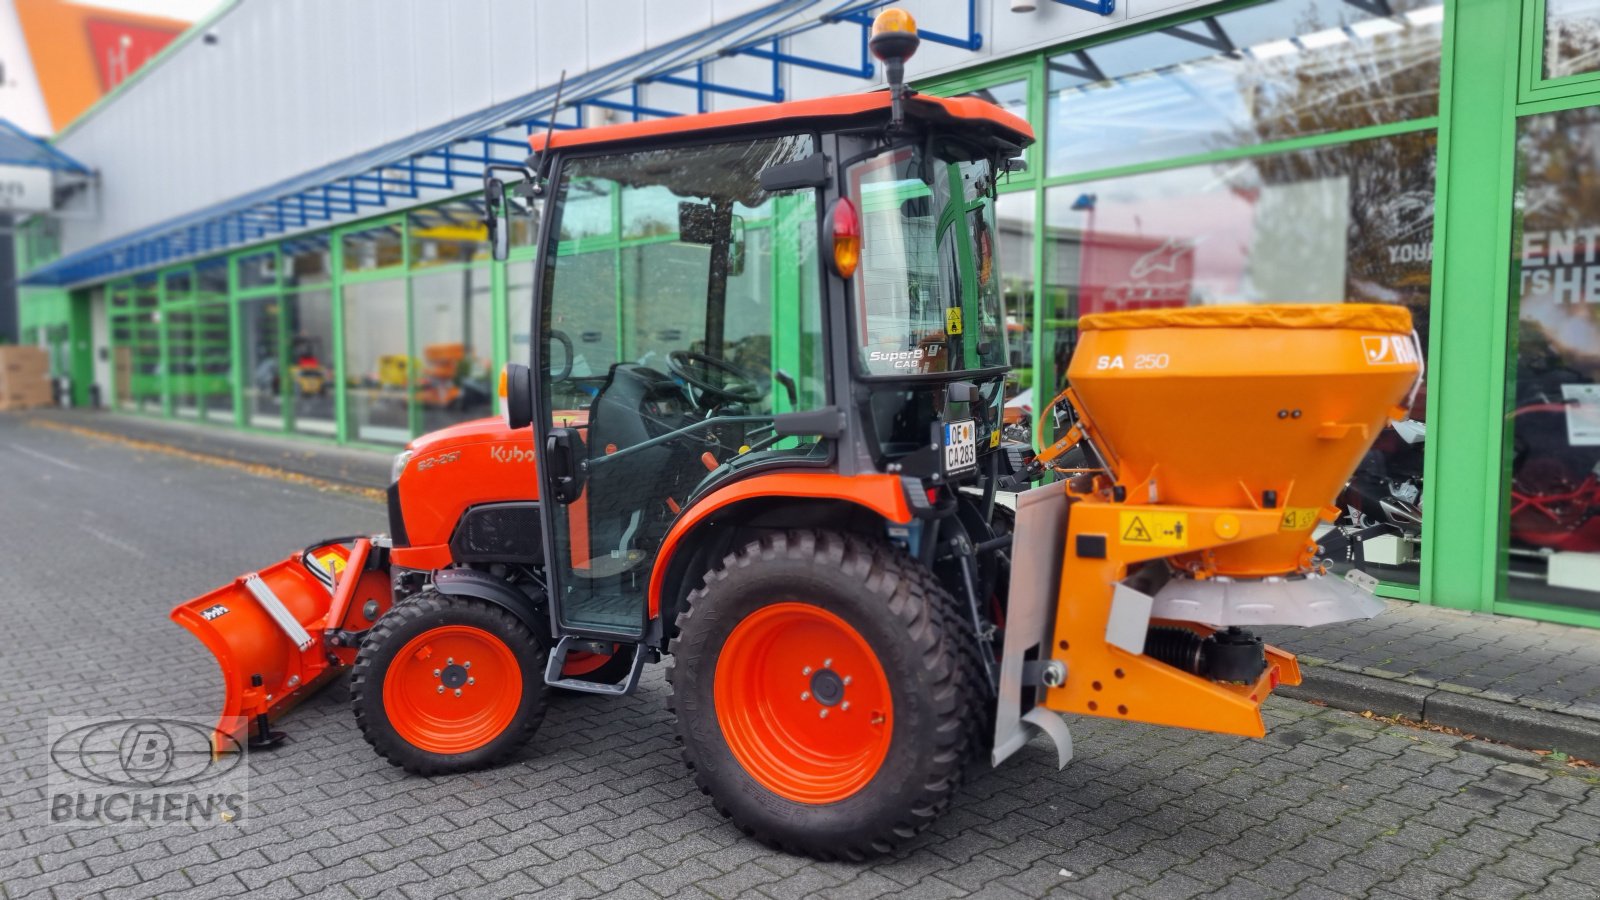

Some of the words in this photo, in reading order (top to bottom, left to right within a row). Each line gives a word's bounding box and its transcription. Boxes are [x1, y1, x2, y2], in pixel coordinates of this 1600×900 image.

[870, 349, 923, 361] SuperB
[1096, 355, 1124, 370] SA
[1134, 353, 1169, 369] 250
[894, 360, 918, 368] CAB
[952, 425, 962, 445] OE
